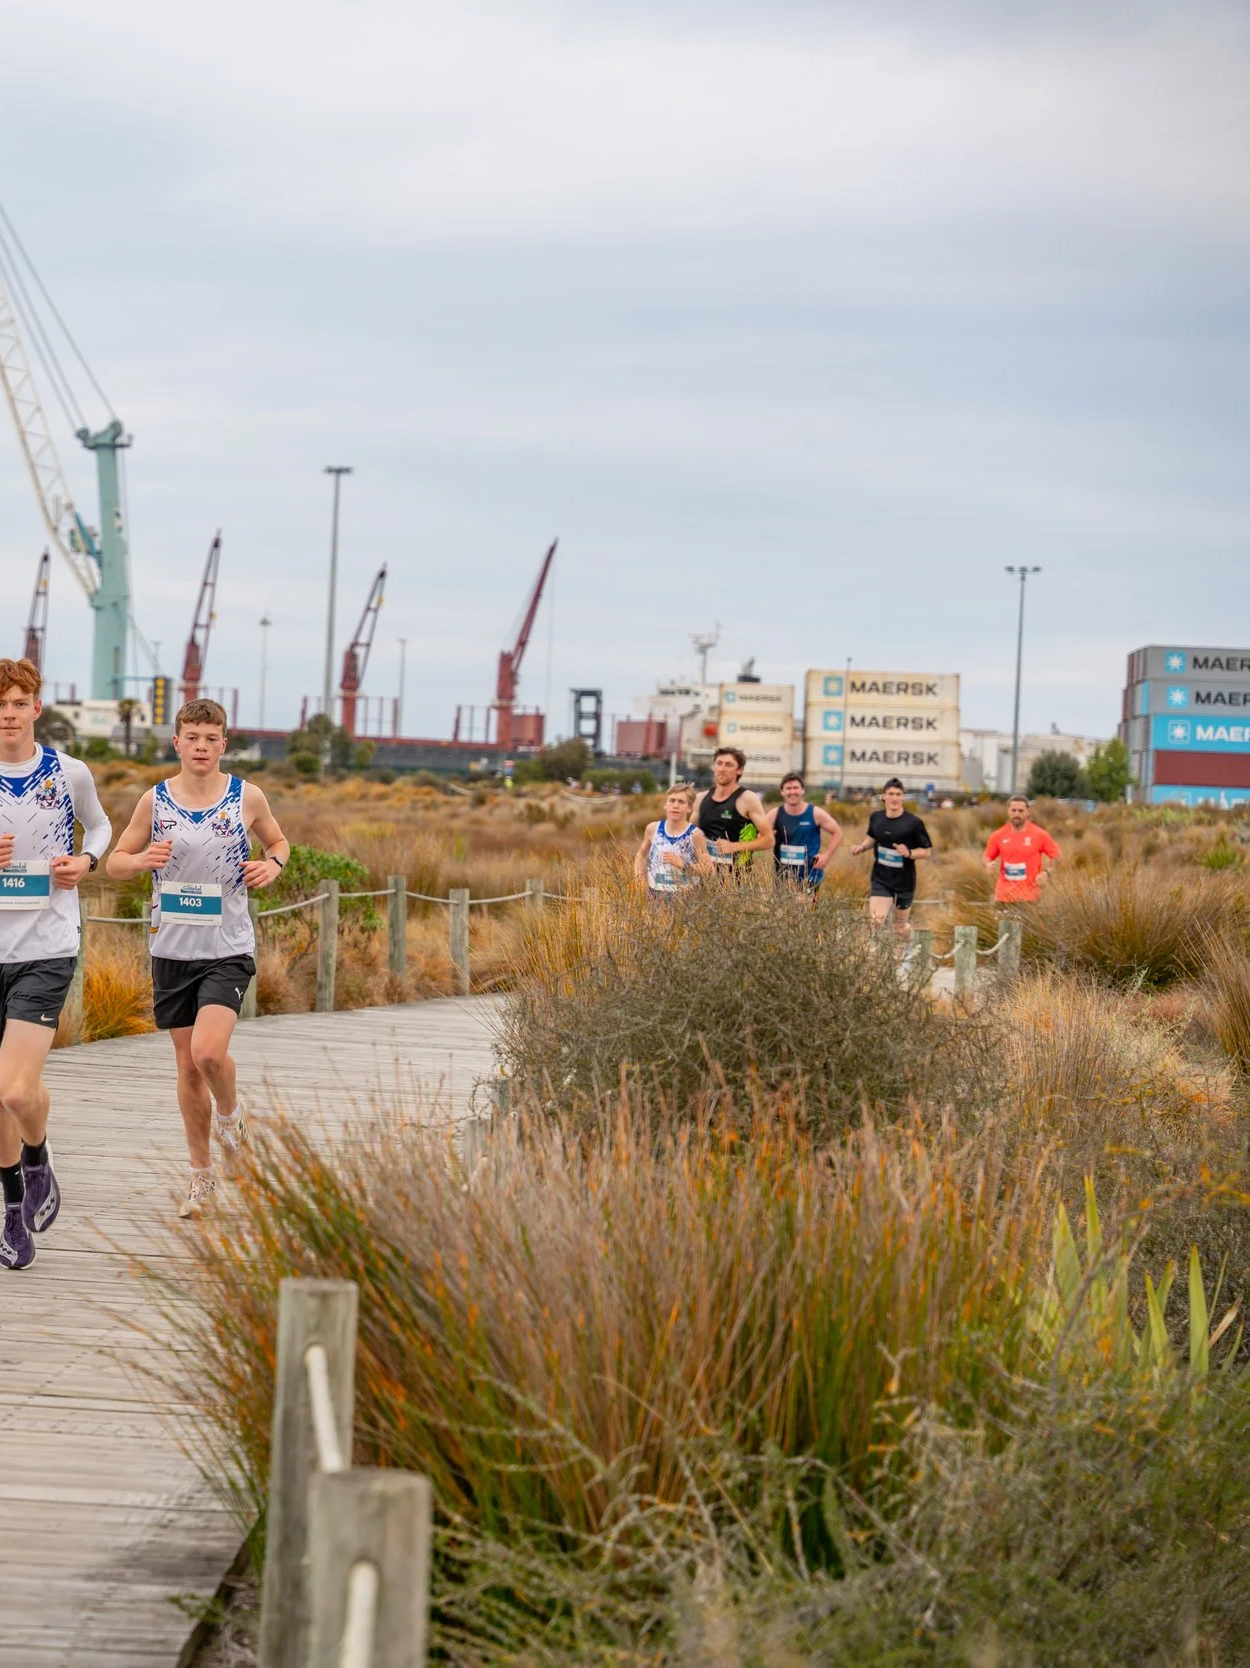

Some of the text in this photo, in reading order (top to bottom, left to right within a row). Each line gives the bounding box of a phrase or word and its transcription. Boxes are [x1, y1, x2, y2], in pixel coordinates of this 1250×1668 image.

[851, 681, 938, 696] MAERSK
[850, 716, 938, 731] MAERSK
[745, 754, 781, 763] AERSK
[851, 750, 938, 766] MAERSK
[2, 877, 26, 888] 1416
[179, 897, 202, 907] 1403
